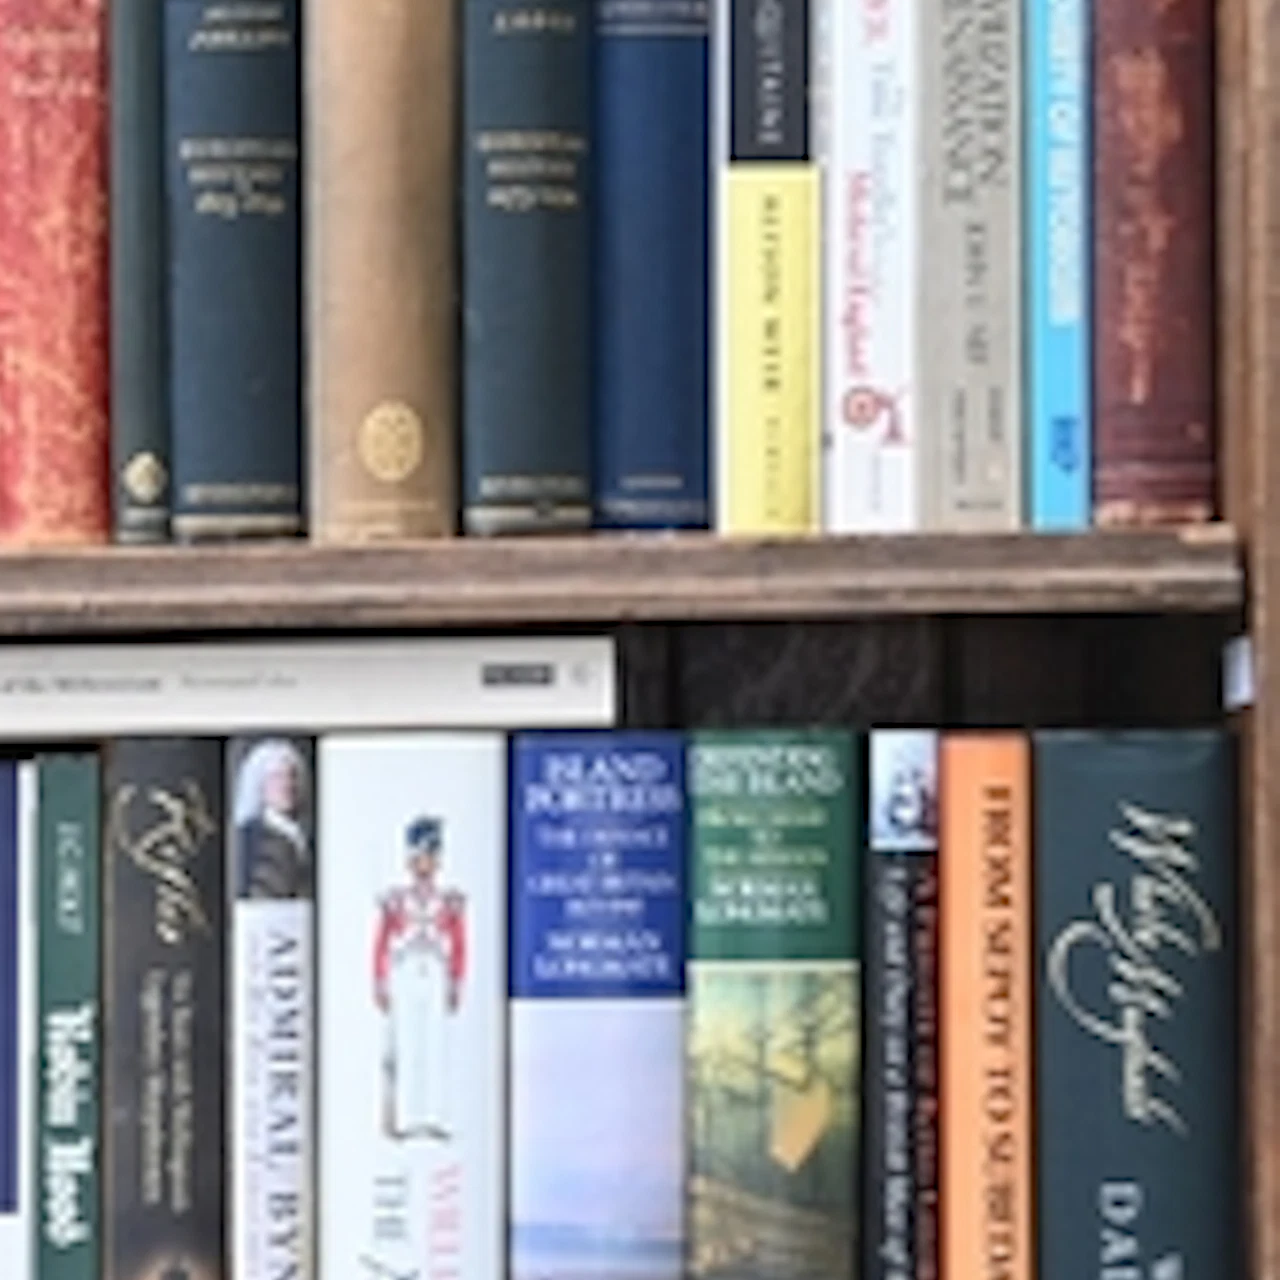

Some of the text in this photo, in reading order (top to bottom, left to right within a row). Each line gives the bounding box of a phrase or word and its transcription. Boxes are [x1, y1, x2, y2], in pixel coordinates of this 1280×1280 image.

[757, 193, 782, 306] ALISON
[757, 317, 782, 393] WEIR
[524, 784, 683, 814] FORTRESS
[543, 752, 669, 783] ISLAND
[114, 782, 220, 946] Rifles
[984, 784, 1016, 910] FROM
[984, 918, 1016, 1054] SEPOY
[265, 927, 301, 1179] ADMIRAL
[984, 1064, 1016, 1122] TO
[43, 1002, 94, 1249] Robin Hood
[372, 1173, 408, 1241] THE
